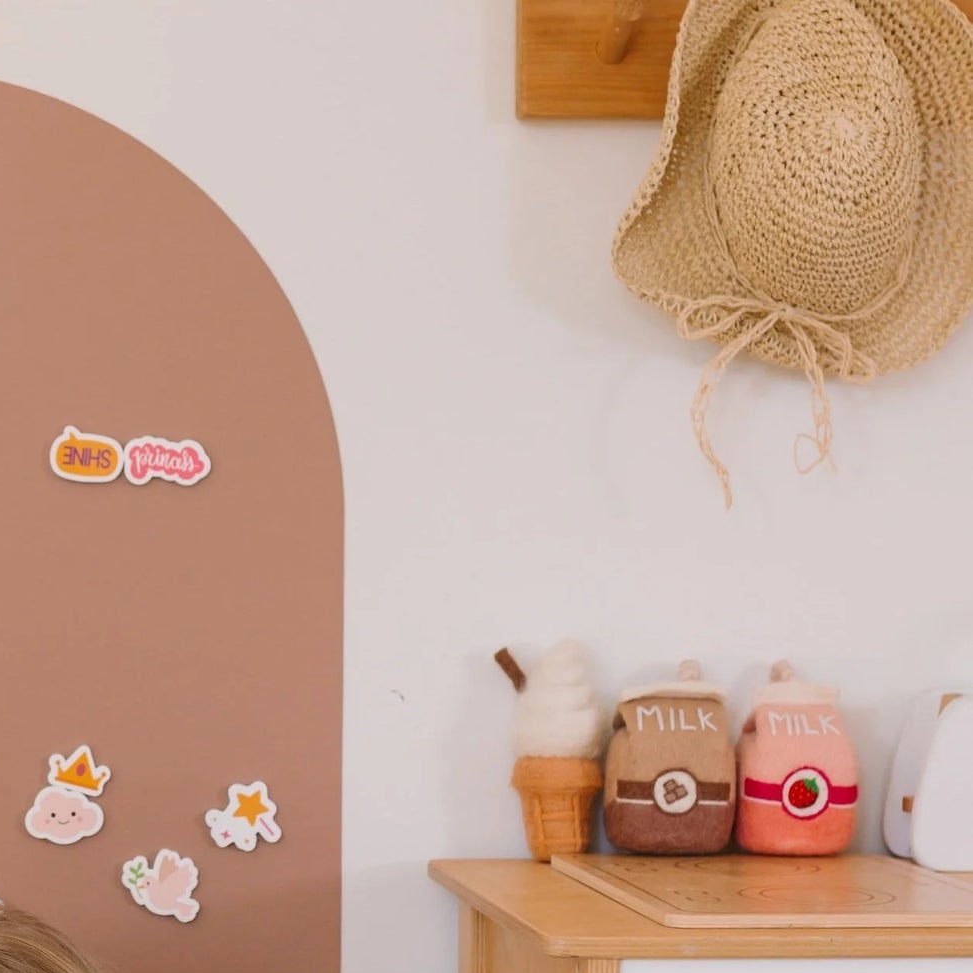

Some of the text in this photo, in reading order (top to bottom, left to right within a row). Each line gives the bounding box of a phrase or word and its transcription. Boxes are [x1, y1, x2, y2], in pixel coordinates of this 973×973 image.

[62, 446, 113, 470] SHINE
[635, 705, 718, 732] MILK
[768, 710, 841, 736] MILK
